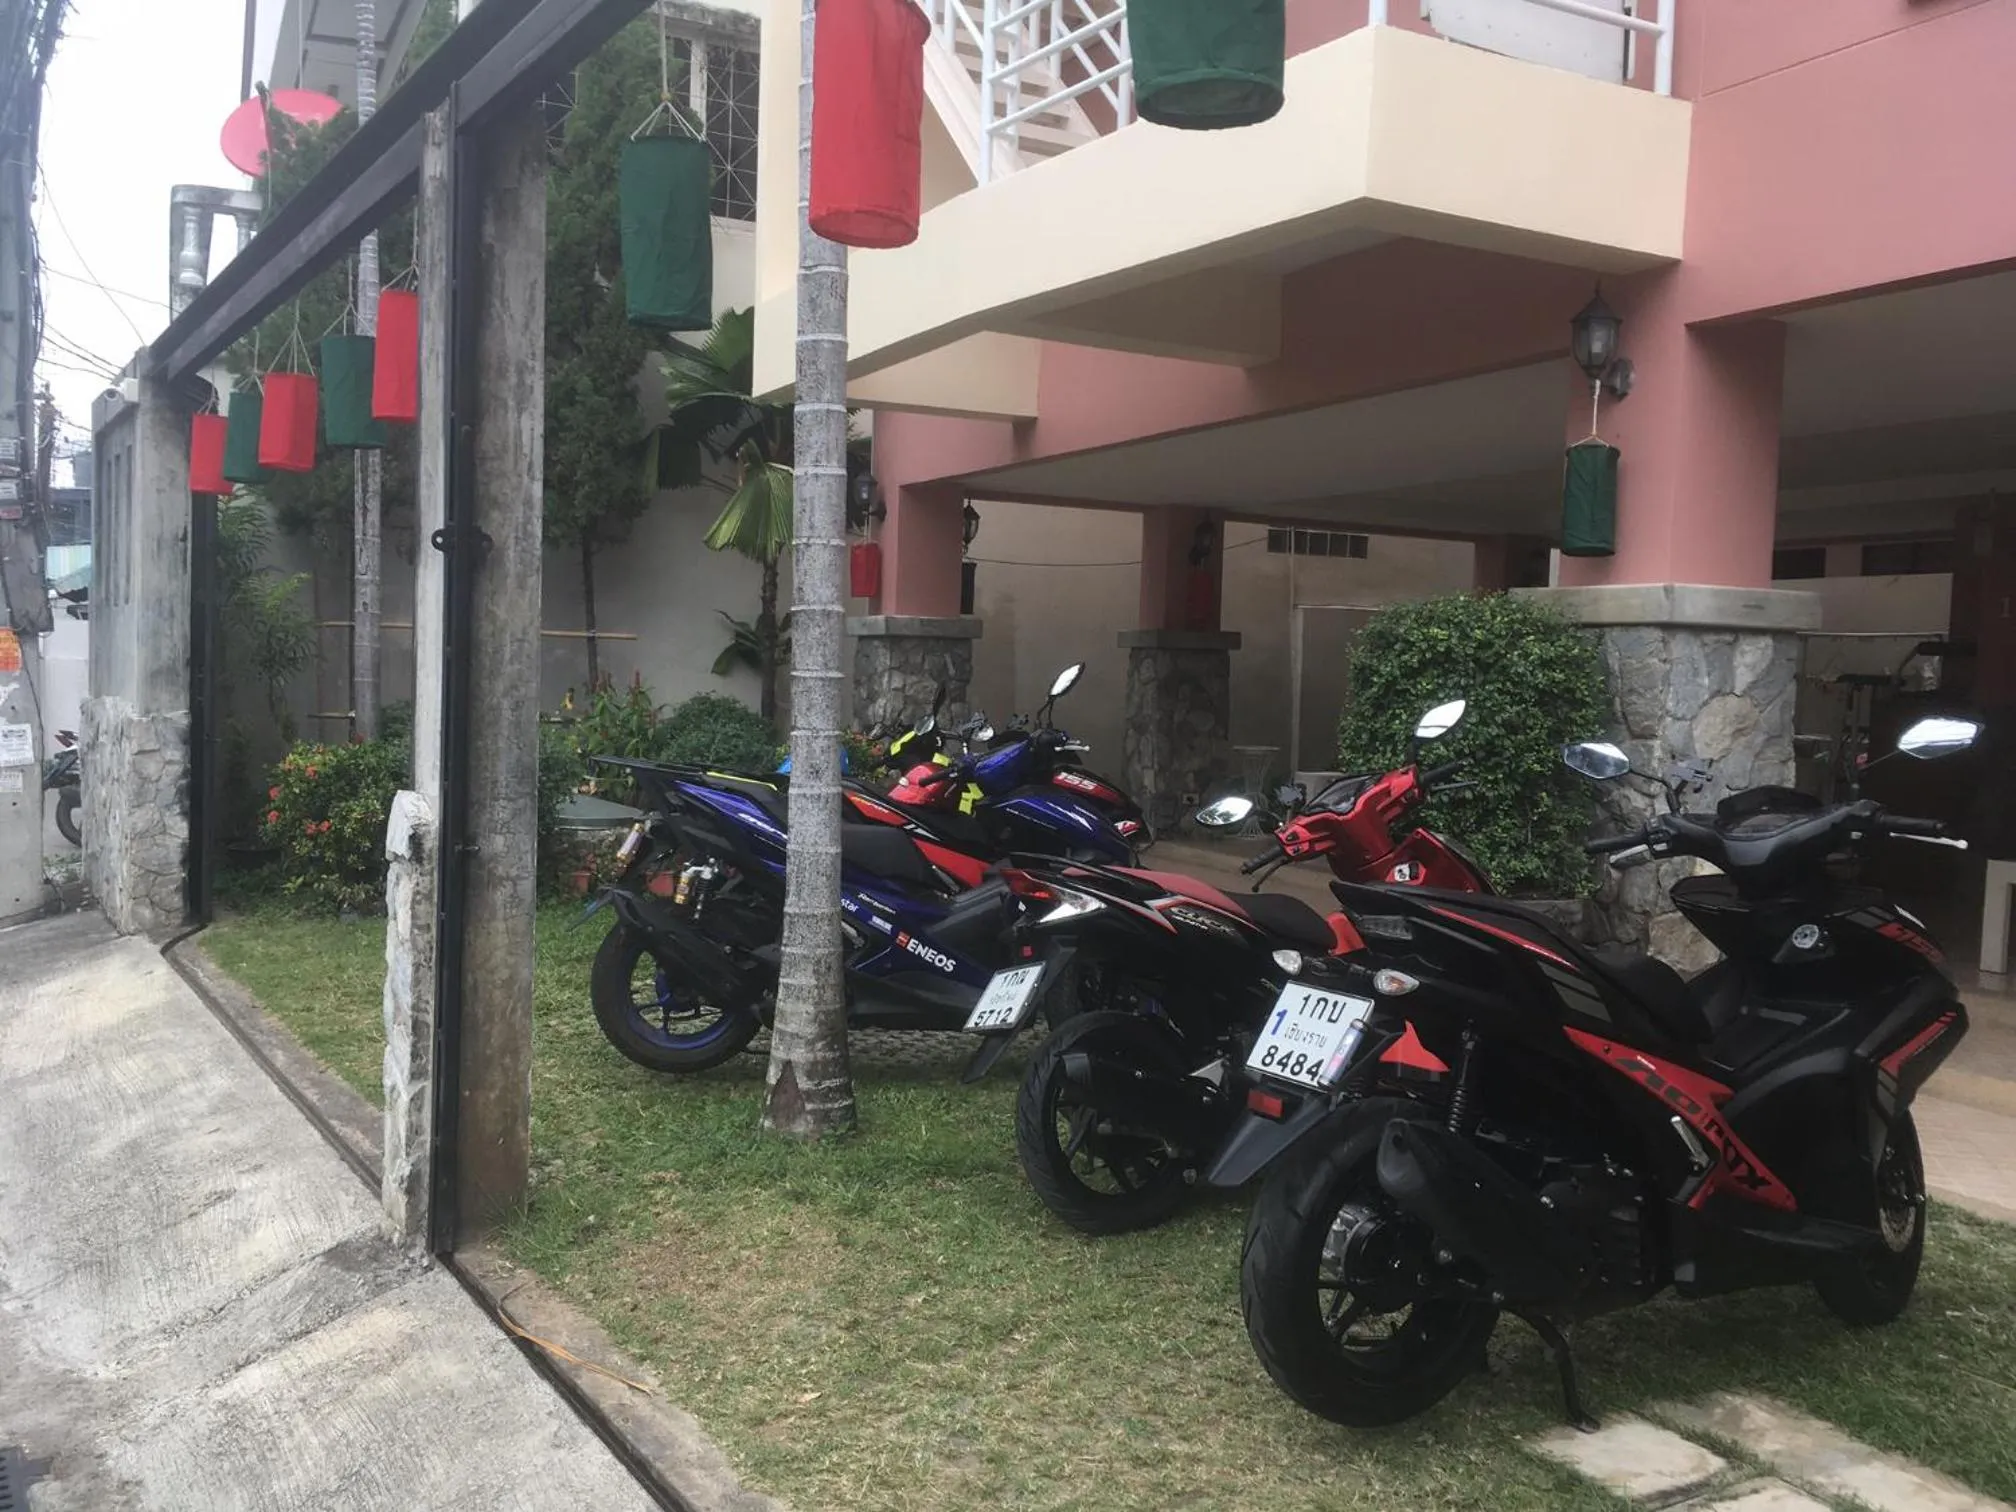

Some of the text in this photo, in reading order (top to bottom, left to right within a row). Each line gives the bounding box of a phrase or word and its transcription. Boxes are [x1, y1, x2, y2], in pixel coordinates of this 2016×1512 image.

[906, 938, 957, 973] ENEOS
[974, 1007, 1013, 1028] 5712
[1271, 1009, 1288, 1036] 1
[1261, 1045, 1325, 1082] 8484
